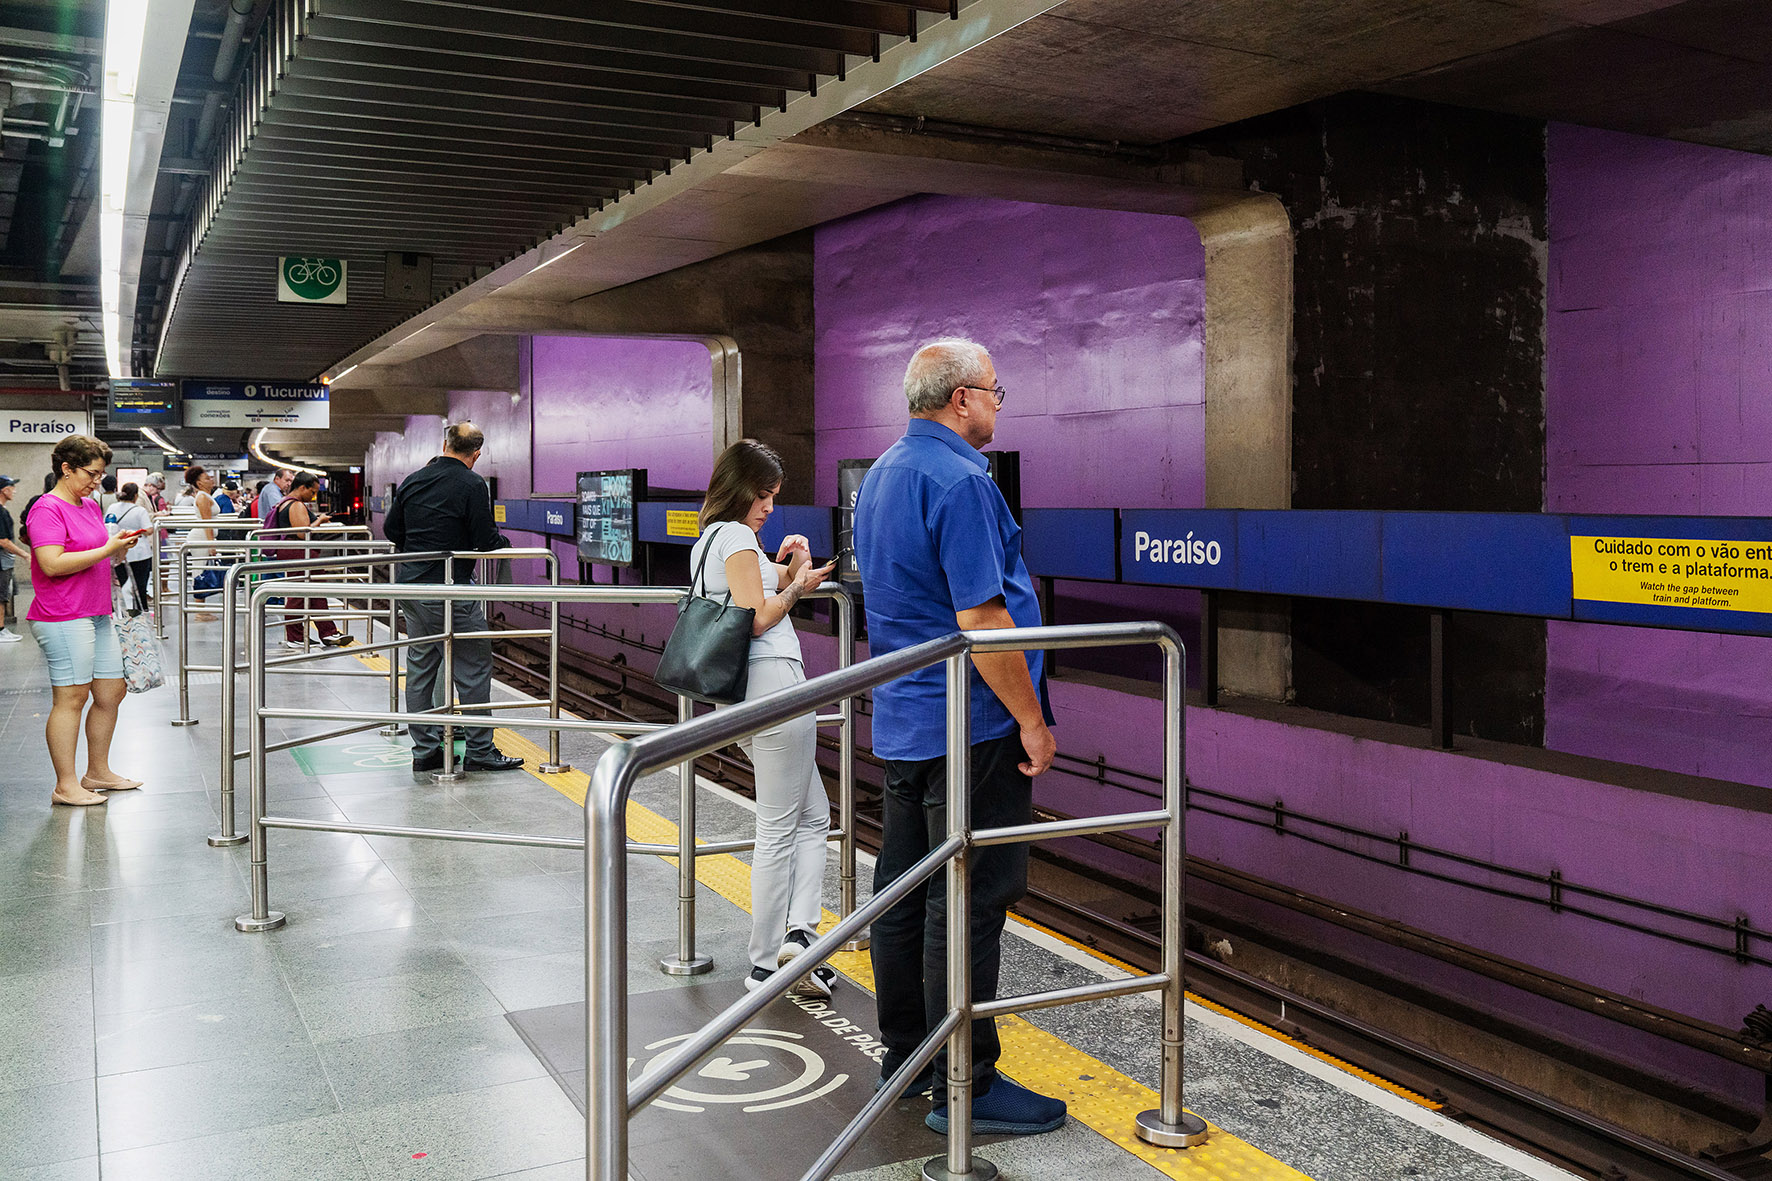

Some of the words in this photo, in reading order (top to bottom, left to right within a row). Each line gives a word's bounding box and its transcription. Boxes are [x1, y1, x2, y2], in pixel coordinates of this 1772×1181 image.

[261, 385, 325, 398] Tucuruvi
[9, 419, 76, 433] Paraíso
[1135, 530, 1221, 565] Paraíso
[1594, 538, 1653, 556] Cuidado
[1658, 544, 1691, 558] com
[1696, 546, 1706, 558] o
[1710, 543, 1740, 559] vão
[1609, 560, 1618, 572] o
[1622, 559, 1654, 574] trem
[1658, 563, 1667, 574] e
[1672, 563, 1681, 575] a
[1640, 581, 1665, 591] Watch
[1667, 583, 1681, 592] the
[1682, 586, 1699, 595] gap
[1701, 585, 1739, 596] between
[1653, 593, 1672, 603] train
[1673, 595, 1690, 604] and
[1691, 596, 1732, 608] platform.
[820, 1017, 863, 1036] DE
